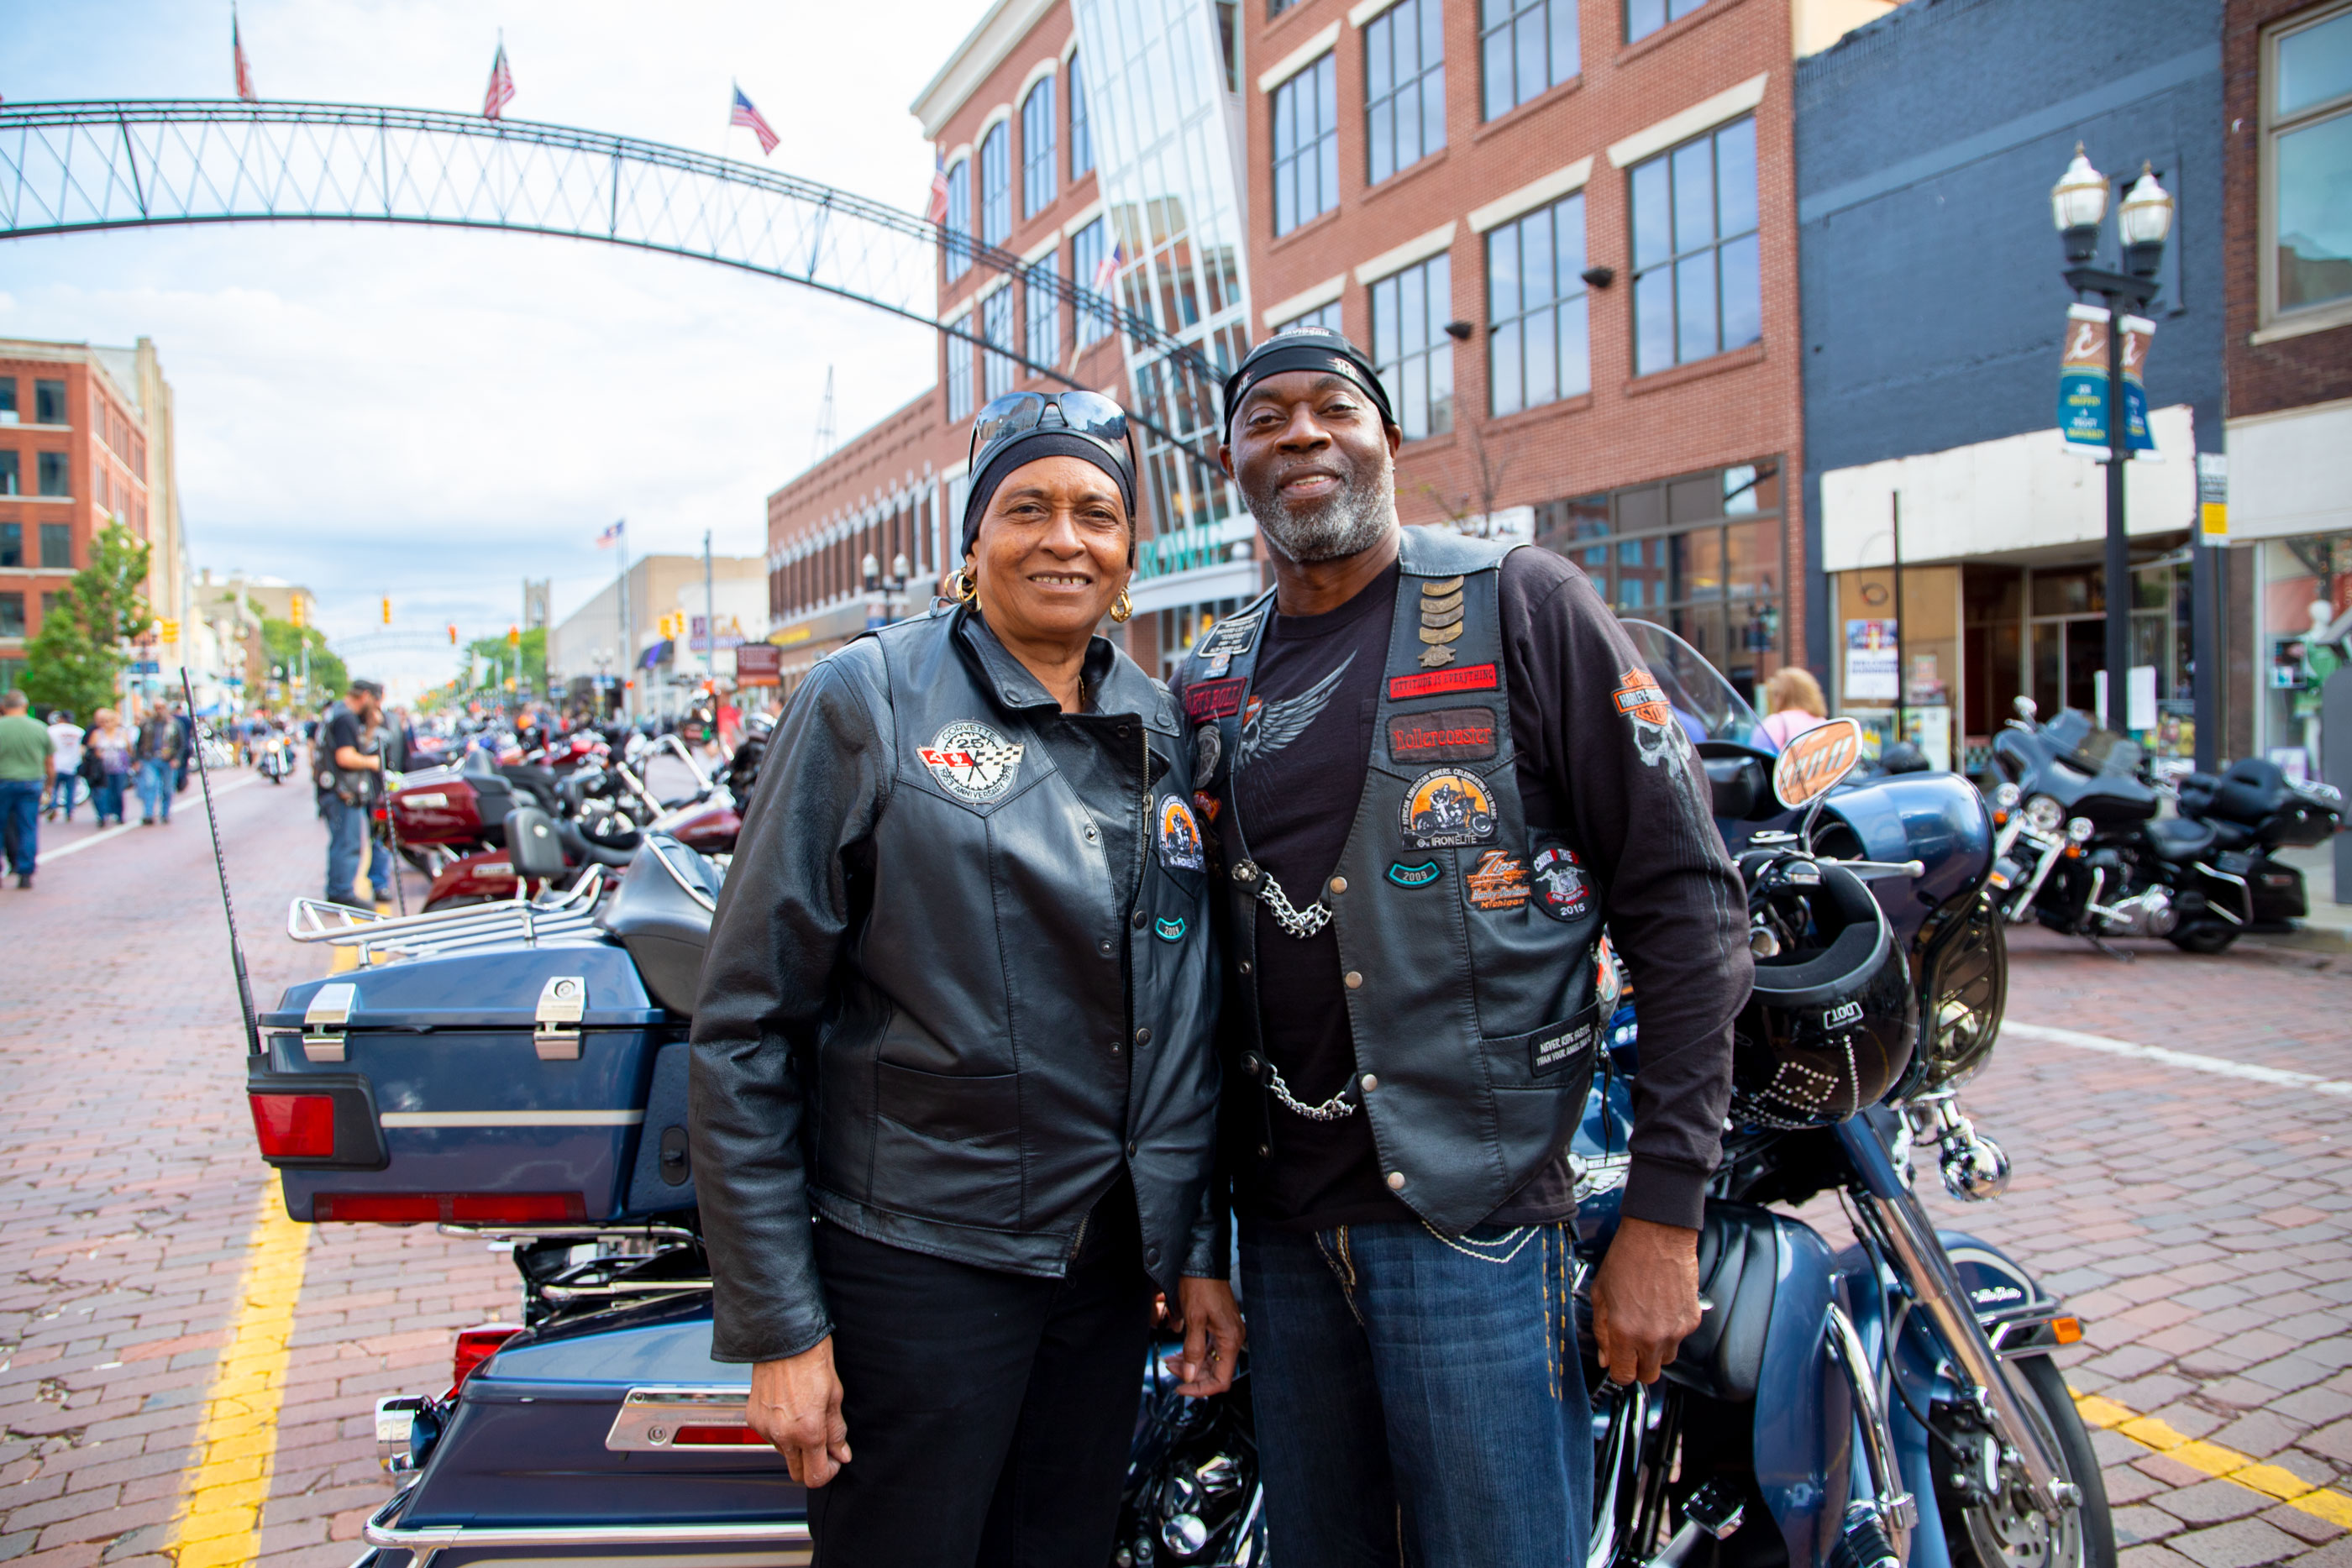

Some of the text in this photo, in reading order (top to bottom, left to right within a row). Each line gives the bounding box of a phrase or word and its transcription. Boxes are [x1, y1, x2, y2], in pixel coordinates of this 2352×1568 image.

[1394, 669, 1494, 691] ATTITUDE IS EVERYTHING
[1210, 685, 1238, 711] ROLL
[942, 724, 997, 740] CORVETTE
[1394, 726, 1492, 751] Rollercoaster
[957, 738, 984, 749] 25
[939, 768, 954, 786] 1953
[1453, 768, 1488, 792] CELEBRATING
[953, 783, 1005, 799] ANNIVERSARY
[1406, 774, 1431, 800] AMERICAN
[1402, 800, 1411, 825] AFRICAN
[1488, 800, 1498, 821] YEARS
[1558, 848, 1573, 863] THE
[1402, 870, 1428, 882] 2009
[1481, 899, 1525, 909] Michigan
[1559, 903, 1586, 916] 2015
[1164, 926, 1180, 936] 2009
[1539, 1037, 1562, 1054] NEVER
[1561, 1032, 1574, 1047] RIDE
[1536, 1053, 1552, 1067] THAN
